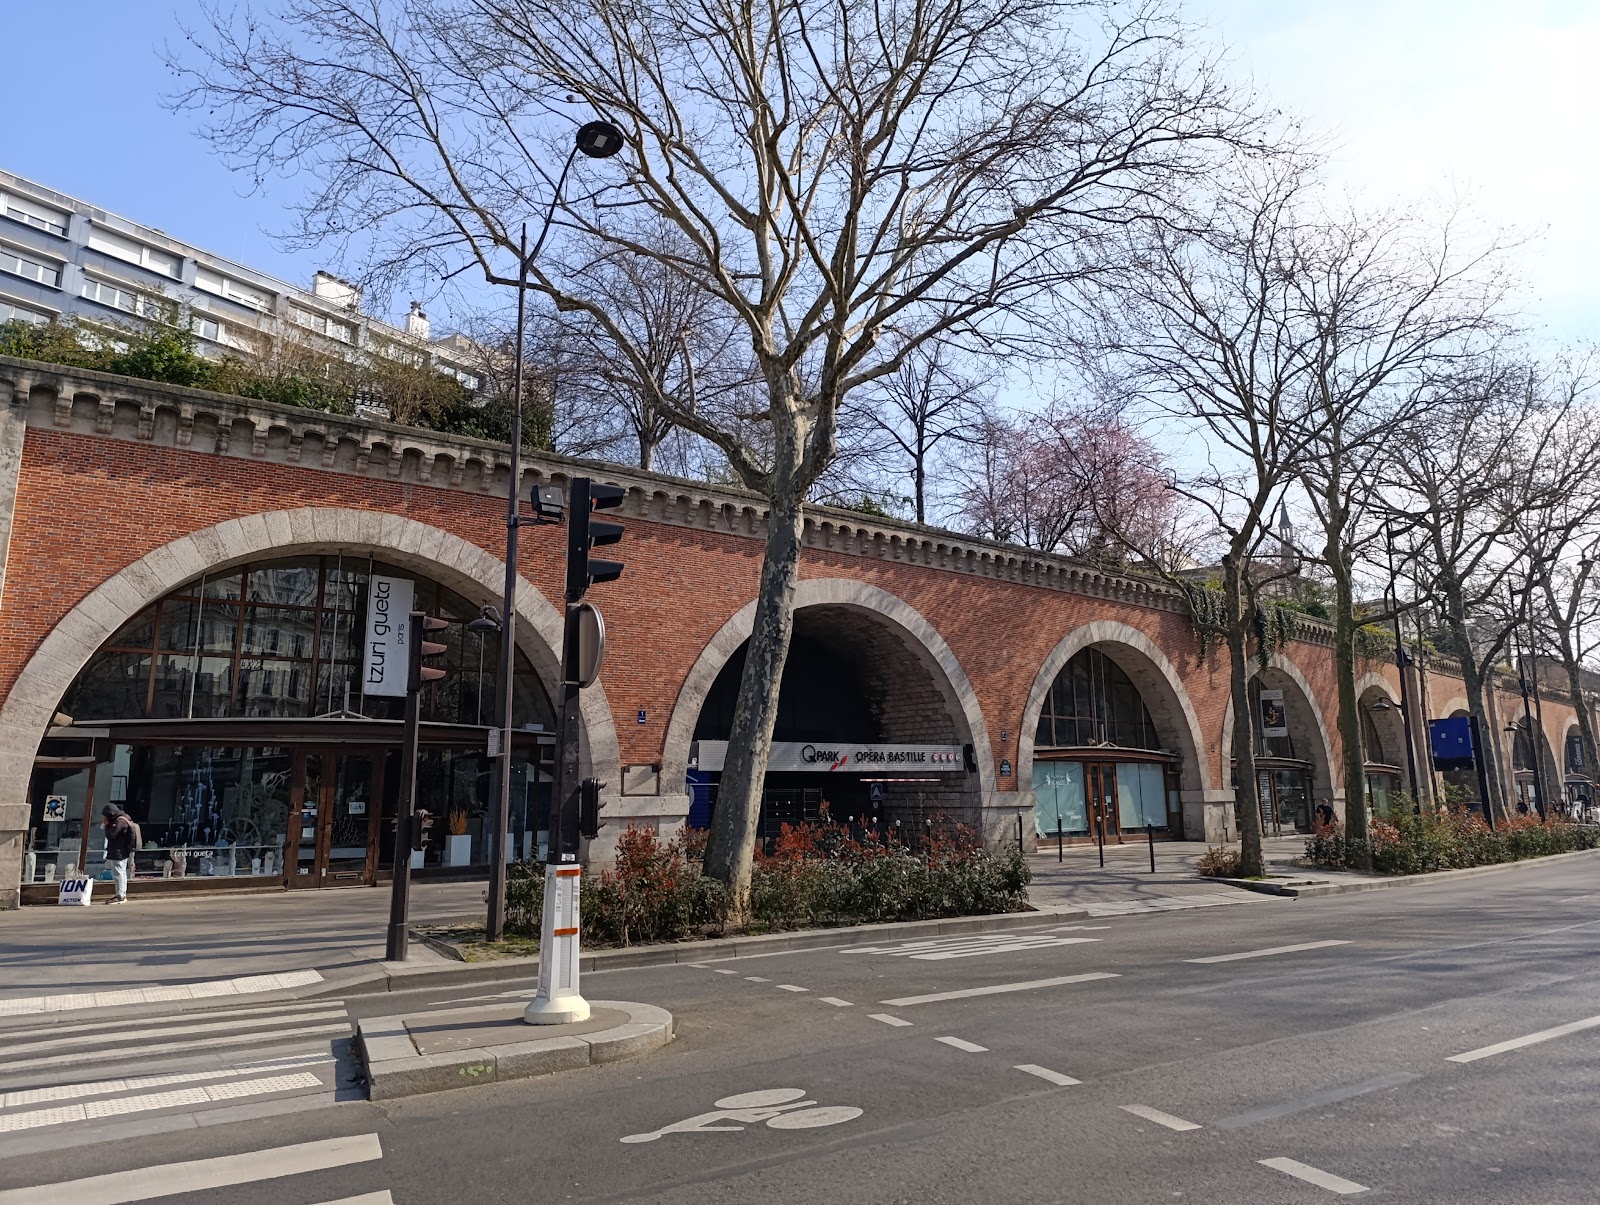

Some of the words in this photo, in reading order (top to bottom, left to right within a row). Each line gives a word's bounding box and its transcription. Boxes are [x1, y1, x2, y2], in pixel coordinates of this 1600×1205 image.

[374, 581, 391, 636] gueta
[397, 623, 405, 645] paris
[367, 641, 385, 683] tzuri
[855, 748, 885, 763] OPÉRA
[888, 751, 926, 763] BASTILLE
[193, 850, 214, 859] gueta
